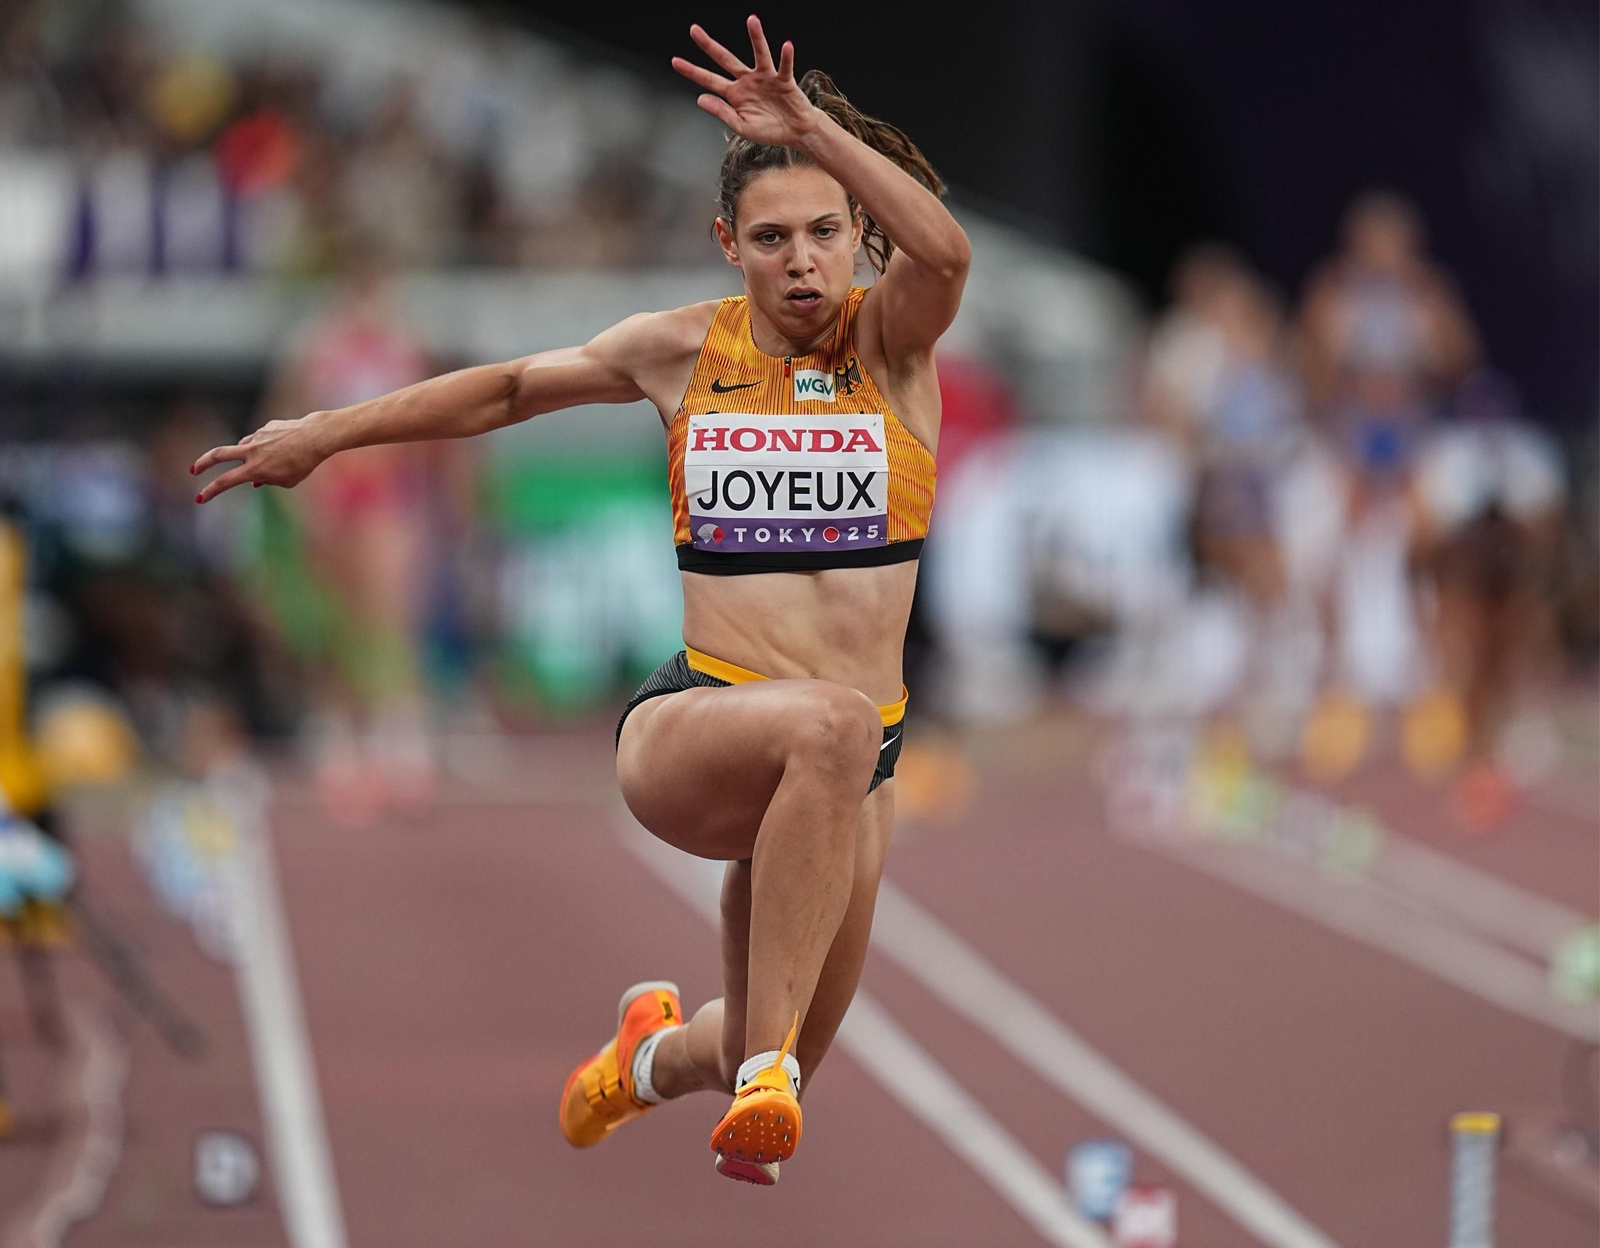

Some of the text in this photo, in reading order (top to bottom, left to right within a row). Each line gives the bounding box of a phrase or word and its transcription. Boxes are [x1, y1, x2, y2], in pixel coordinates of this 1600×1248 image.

[796, 378, 833, 395] WGV
[690, 427, 883, 453] HONDA
[696, 469, 877, 512] JOYEUX
